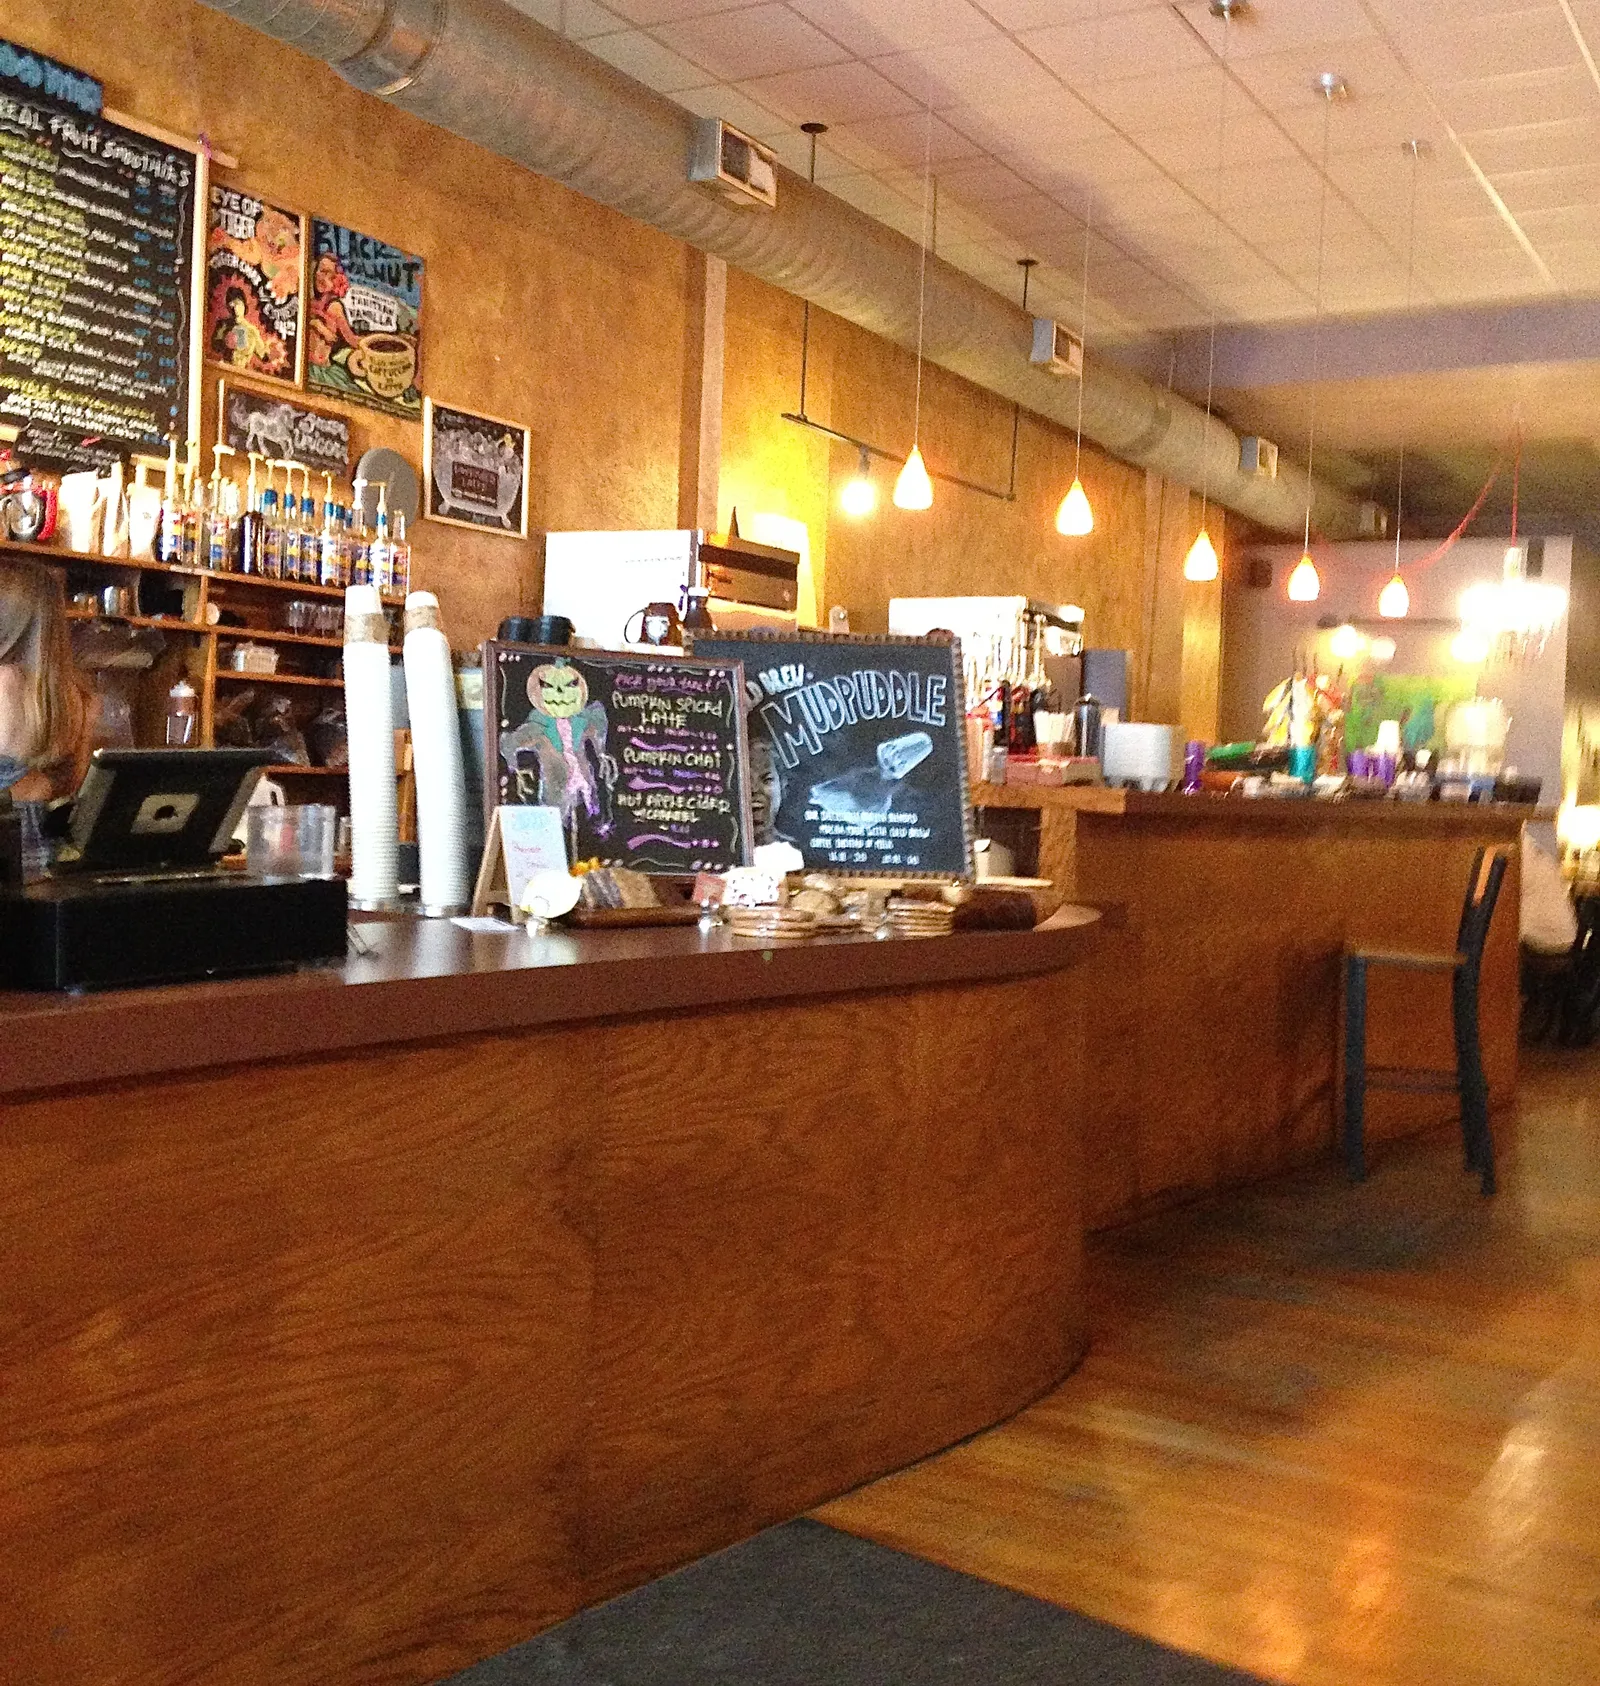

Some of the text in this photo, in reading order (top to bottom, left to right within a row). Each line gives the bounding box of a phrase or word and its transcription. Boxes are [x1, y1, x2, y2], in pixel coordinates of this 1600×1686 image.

[48, 115, 98, 153] FRUIT
[101, 140, 191, 187] SMOOTHIES
[210, 186, 262, 217] EYE OF
[313, 221, 400, 260] BLACK
[611, 690, 672, 712] PUMPKIN
[640, 711, 688, 729] LATTE
[760, 670, 947, 770] MUDPUDDLE
[623, 746, 682, 766] PUMPKIN
